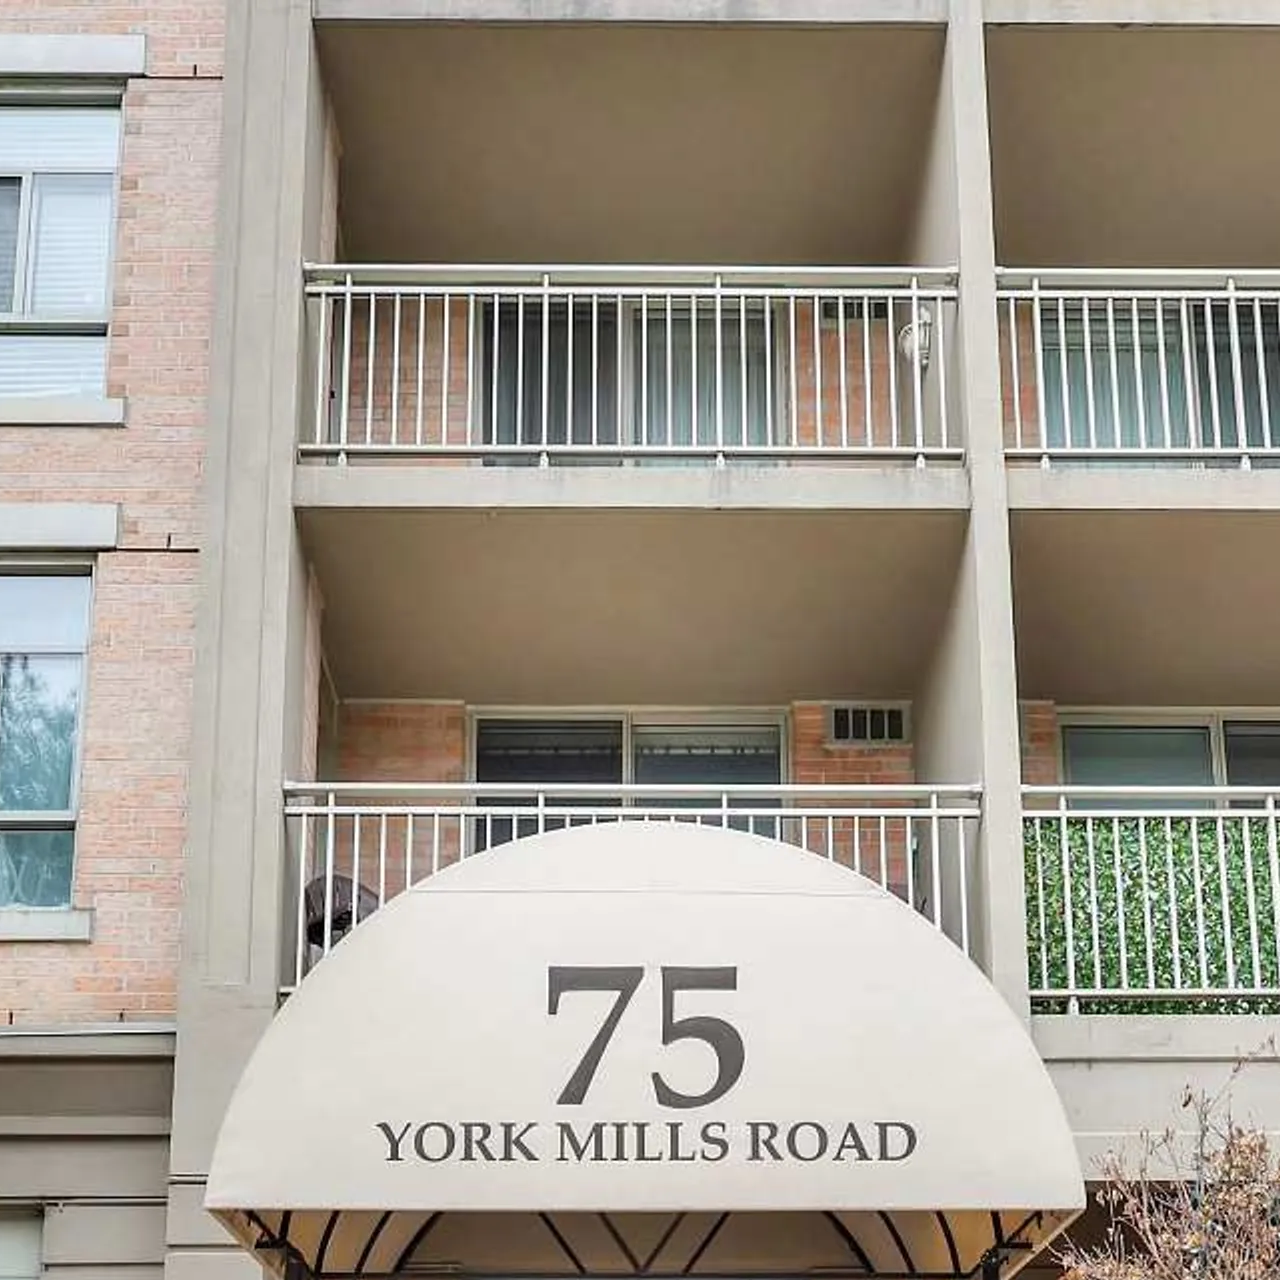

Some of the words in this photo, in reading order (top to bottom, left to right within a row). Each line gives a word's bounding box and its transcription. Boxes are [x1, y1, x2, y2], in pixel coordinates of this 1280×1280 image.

[548, 967, 745, 1109] 75
[376, 1121, 540, 1163] YORK
[556, 1121, 729, 1163] MILLS
[746, 1121, 917, 1163] ROAD
